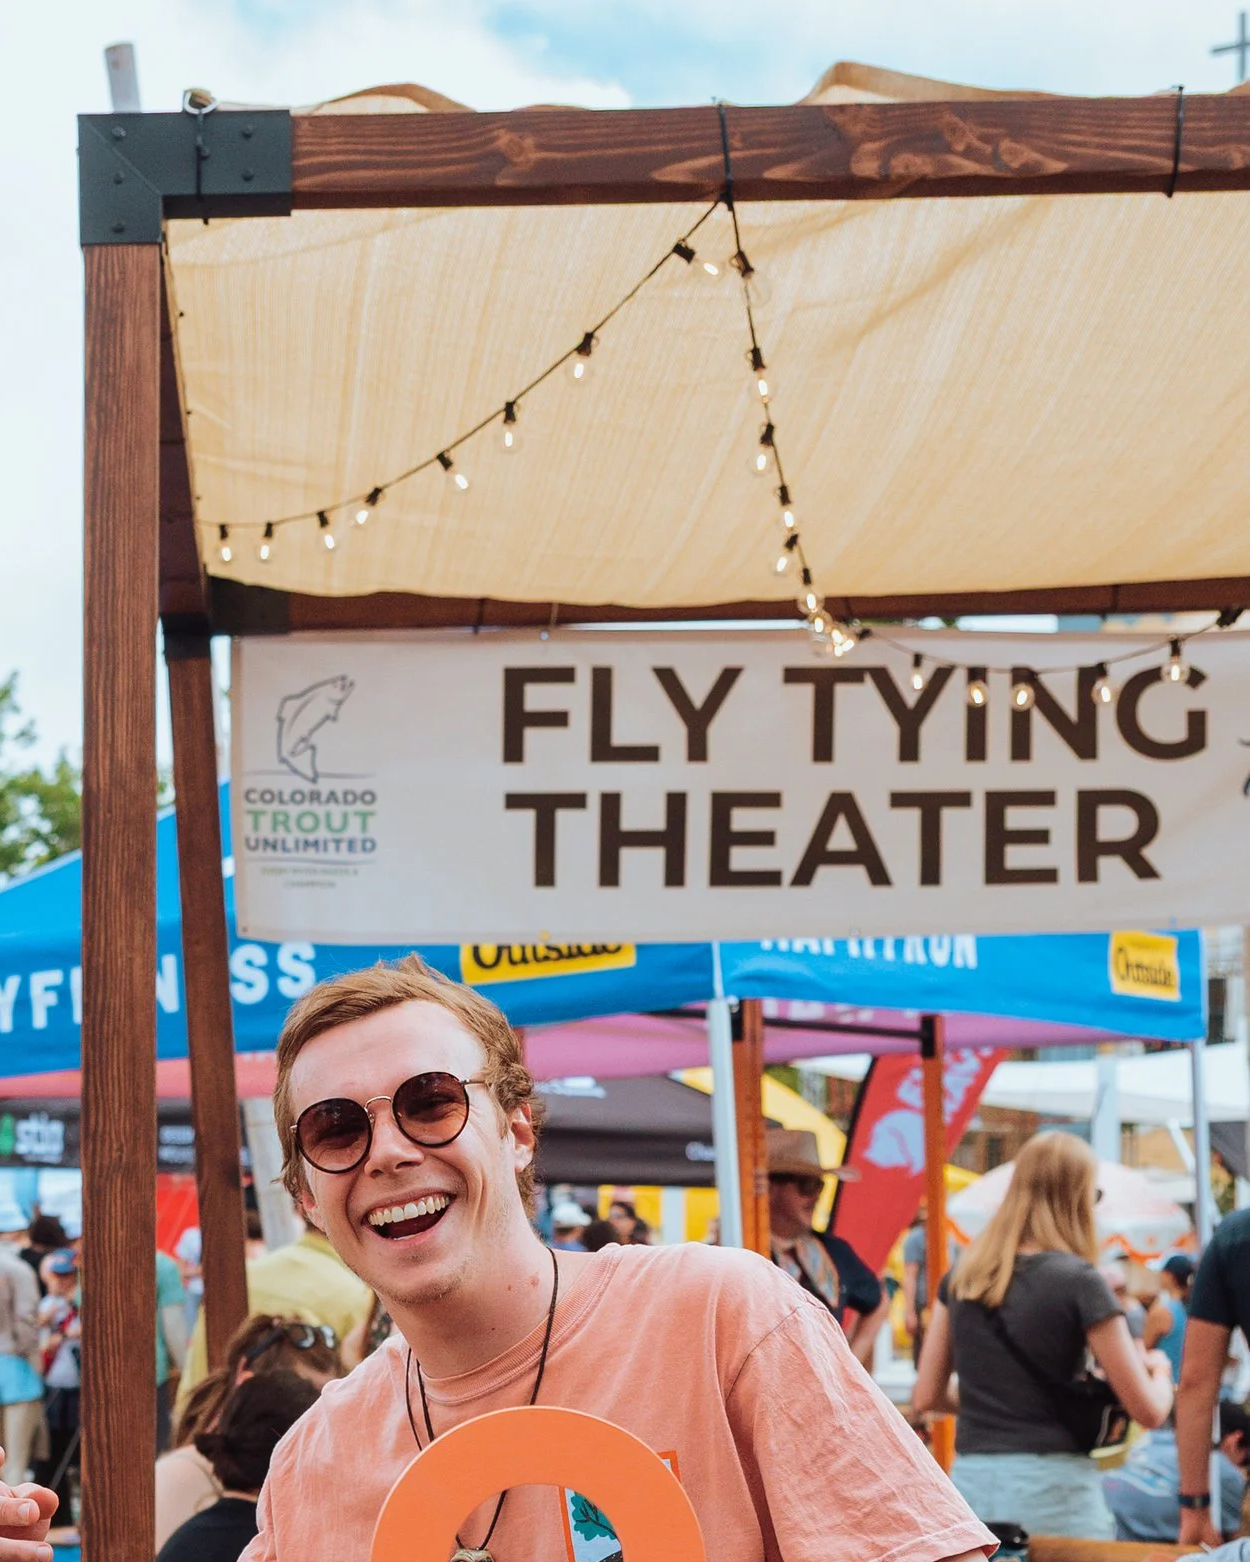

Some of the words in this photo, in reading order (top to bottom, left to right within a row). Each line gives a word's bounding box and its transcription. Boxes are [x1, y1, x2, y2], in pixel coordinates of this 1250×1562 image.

[502, 666, 744, 764] FLY
[783, 664, 1208, 763] TYING
[244, 788, 377, 805] COLORADO
[245, 809, 377, 834] TROUT
[244, 836, 378, 855] UNLIMITED
[505, 788, 1162, 888] THEATER
